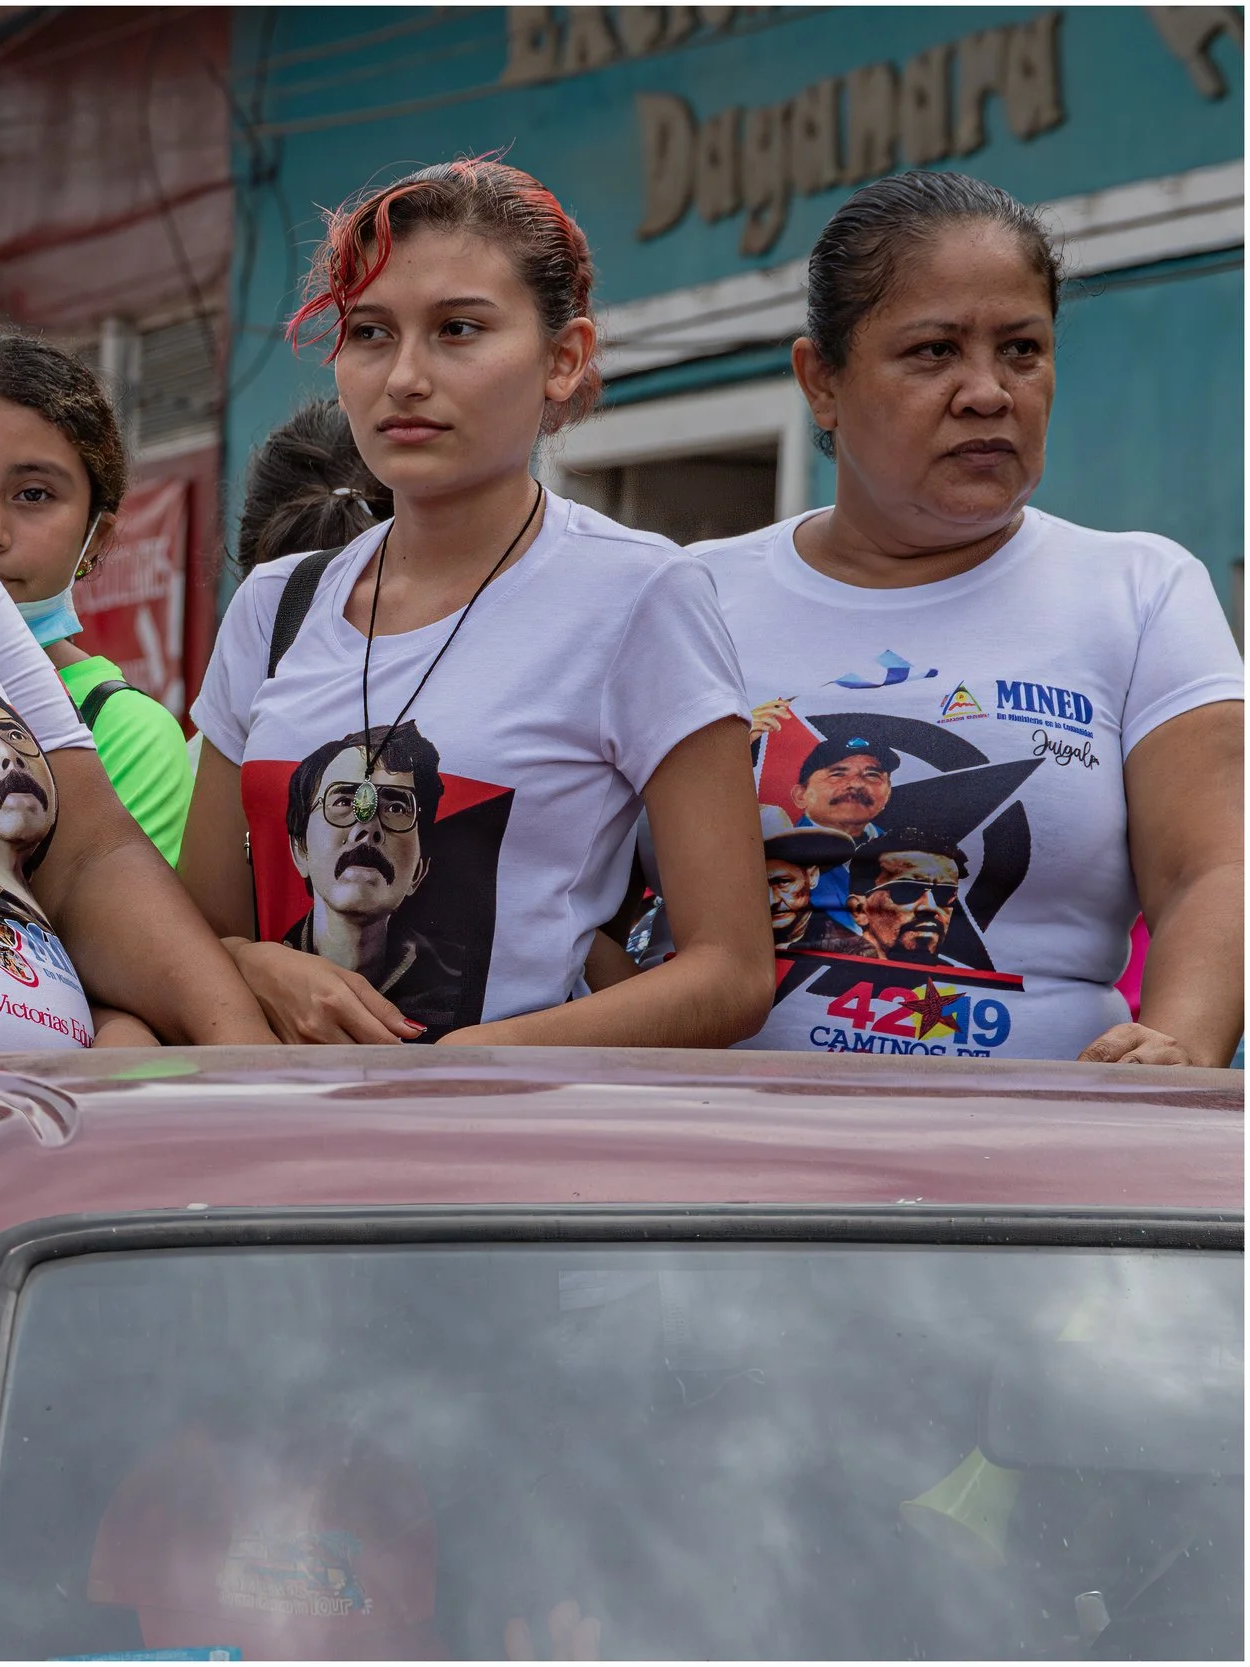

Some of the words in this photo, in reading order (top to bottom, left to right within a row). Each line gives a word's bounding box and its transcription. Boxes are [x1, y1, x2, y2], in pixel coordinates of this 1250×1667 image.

[995, 679, 1094, 726] MINED
[827, 981, 919, 1038] 42
[941, 996, 1011, 1048] 19
[809, 1025, 947, 1056] CAMINOS
